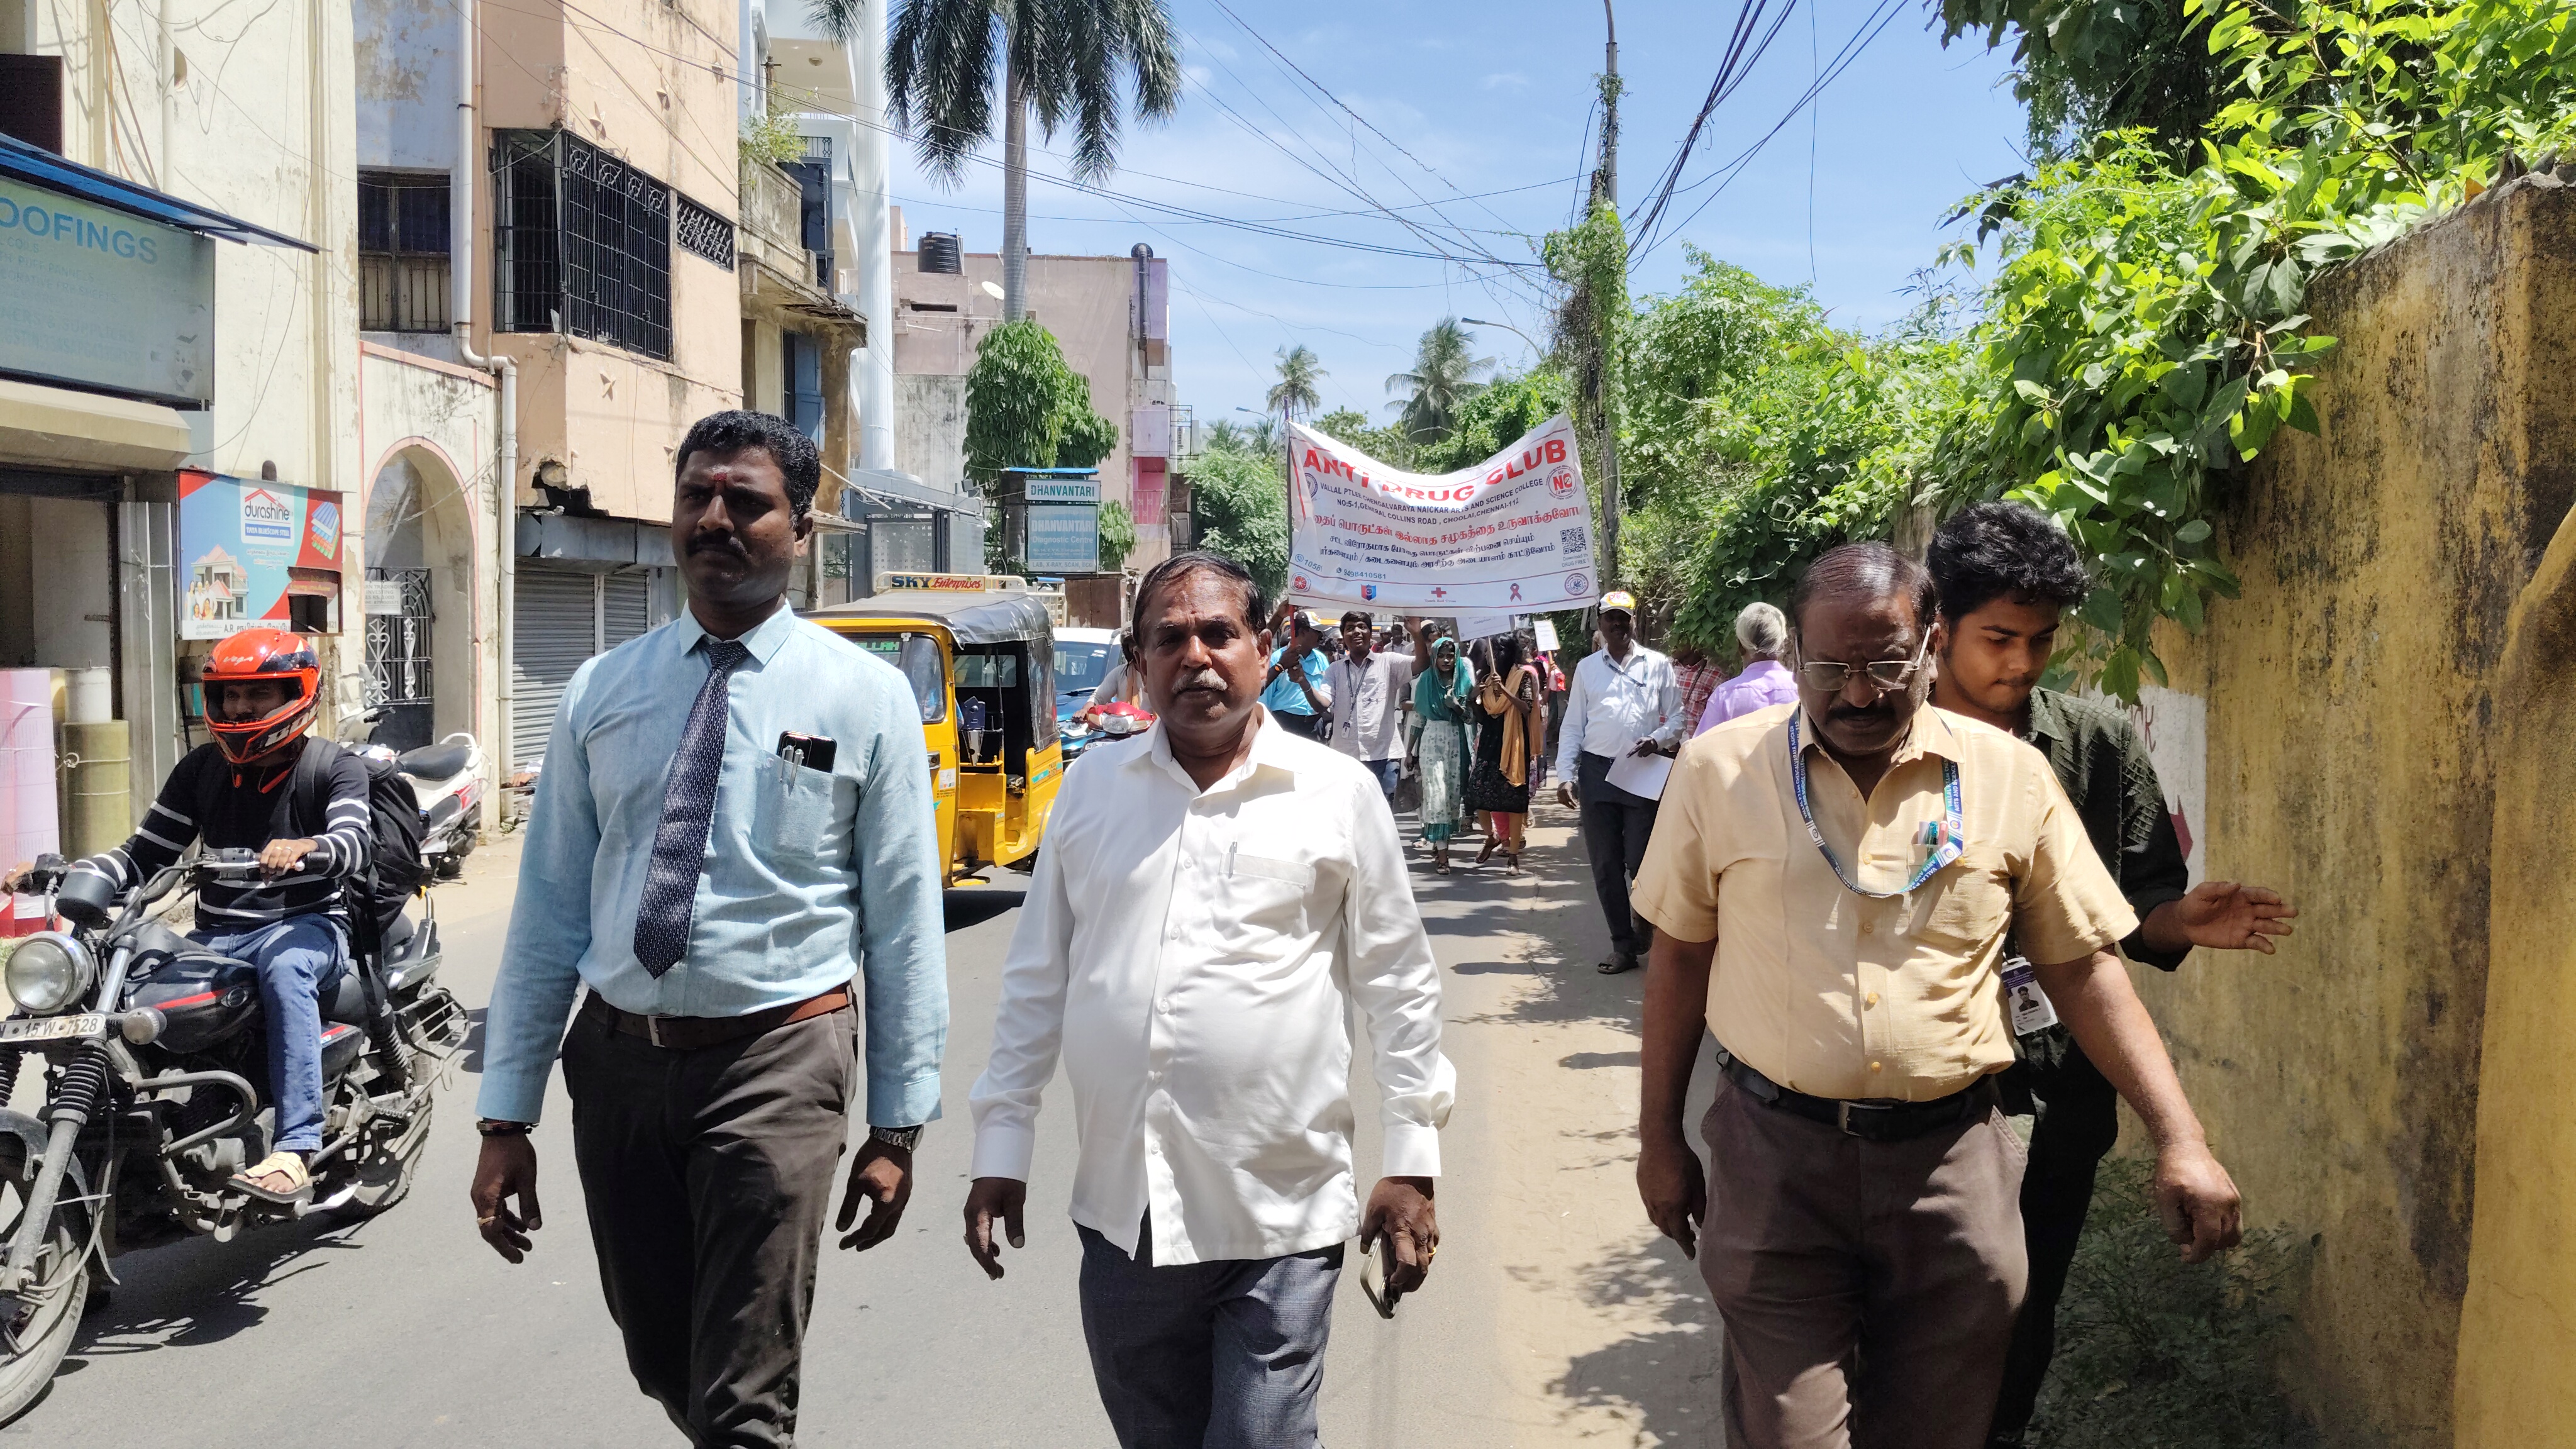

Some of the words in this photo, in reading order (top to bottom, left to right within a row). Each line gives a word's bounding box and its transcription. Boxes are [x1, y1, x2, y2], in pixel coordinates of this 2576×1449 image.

[0, 197, 158, 265] OOFINGS
[1303, 450, 1370, 488] ANTI
[1382, 480, 1475, 501] DRUG
[1485, 439, 1567, 485] CLUB
[1031, 485, 1094, 497] DHANVANTARI
[1553, 473, 1572, 491] NO
[1320, 482, 1341, 494] VALLAL
[1343, 487, 1362, 499] PTLEE
[1363, 495, 1415, 513] CHENGALVARAYA
[1450, 504, 1469, 513] ARS
[1470, 501, 1484, 510] AND
[1486, 490, 1514, 506] SCIENCE
[1515, 478, 1543, 494] COLLEGE
[245, 501, 289, 521] durashine
[1387, 513, 1416, 523] COLLINS
[1031, 519, 1095, 532] DHANVANTARI
[1338, 519, 1393, 536] பொருட்கள்
[1394, 530, 1438, 546] இல்லாத
[1033, 536, 1069, 545] Diagnostic
[892, 575, 932, 588] SKY
[931, 576, 982, 590] Enterprises
[1343, 569, 1386, 580] 9498410581
[25, 1022, 41, 1038] 15
[43, 1021, 57, 1036] W
[67, 1018, 98, 1035] 7528
